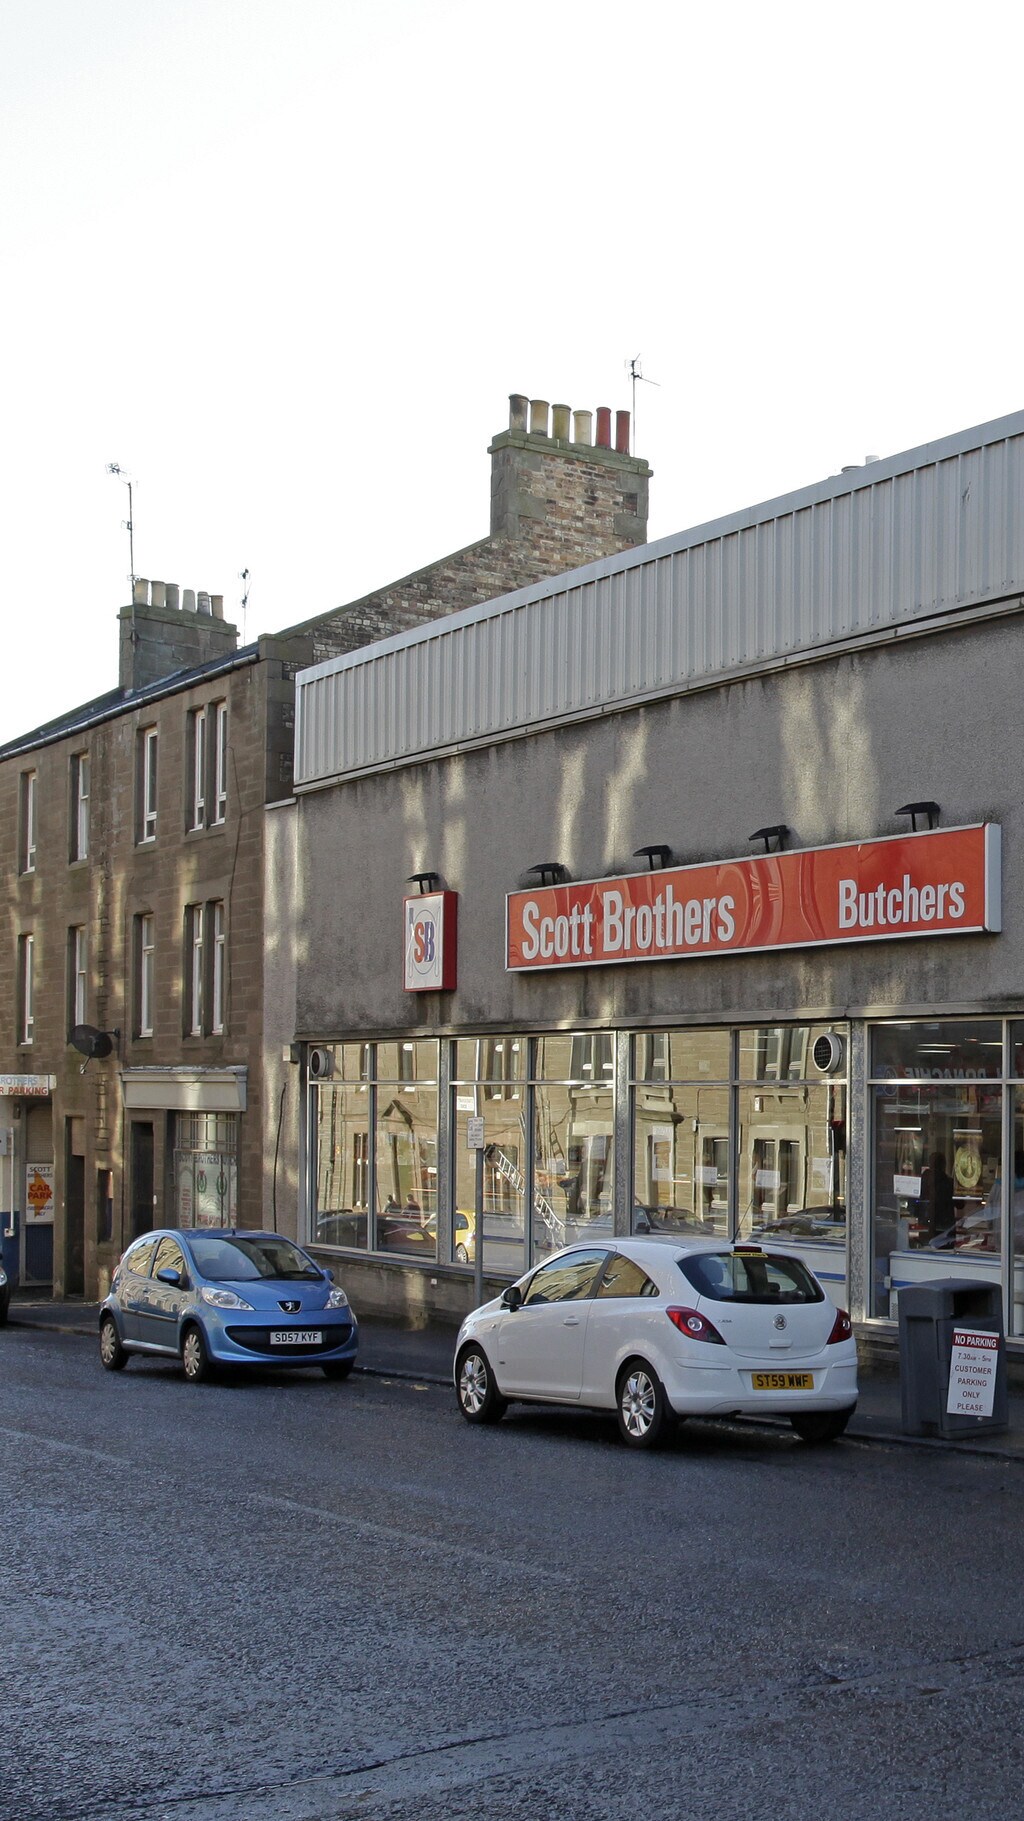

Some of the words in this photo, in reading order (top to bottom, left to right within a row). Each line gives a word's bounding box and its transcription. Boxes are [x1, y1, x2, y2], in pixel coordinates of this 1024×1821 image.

[521, 901, 594, 960] Scott
[602, 884, 736, 952] Brothers
[838, 874, 966, 929] Butchers
[414, 920, 435, 963] SB
[0, 1076, 38, 1086] ROTHERS
[8, 1086, 48, 1095] PARKING
[29, 1184, 50, 1192] CAR
[28, 1191, 53, 1199] PARK
[275, 1332, 299, 1342] SD57
[301, 1332, 318, 1342] KYF
[954, 1334, 965, 1345] NO
[966, 1336, 997, 1348] PARKING
[954, 1364, 992, 1375] CUSTOMER
[756, 1374, 786, 1387] ST59
[957, 1377, 987, 1387] PARKING
[962, 1390, 980, 1398] ONLY
[956, 1403, 984, 1412] PLEASE
